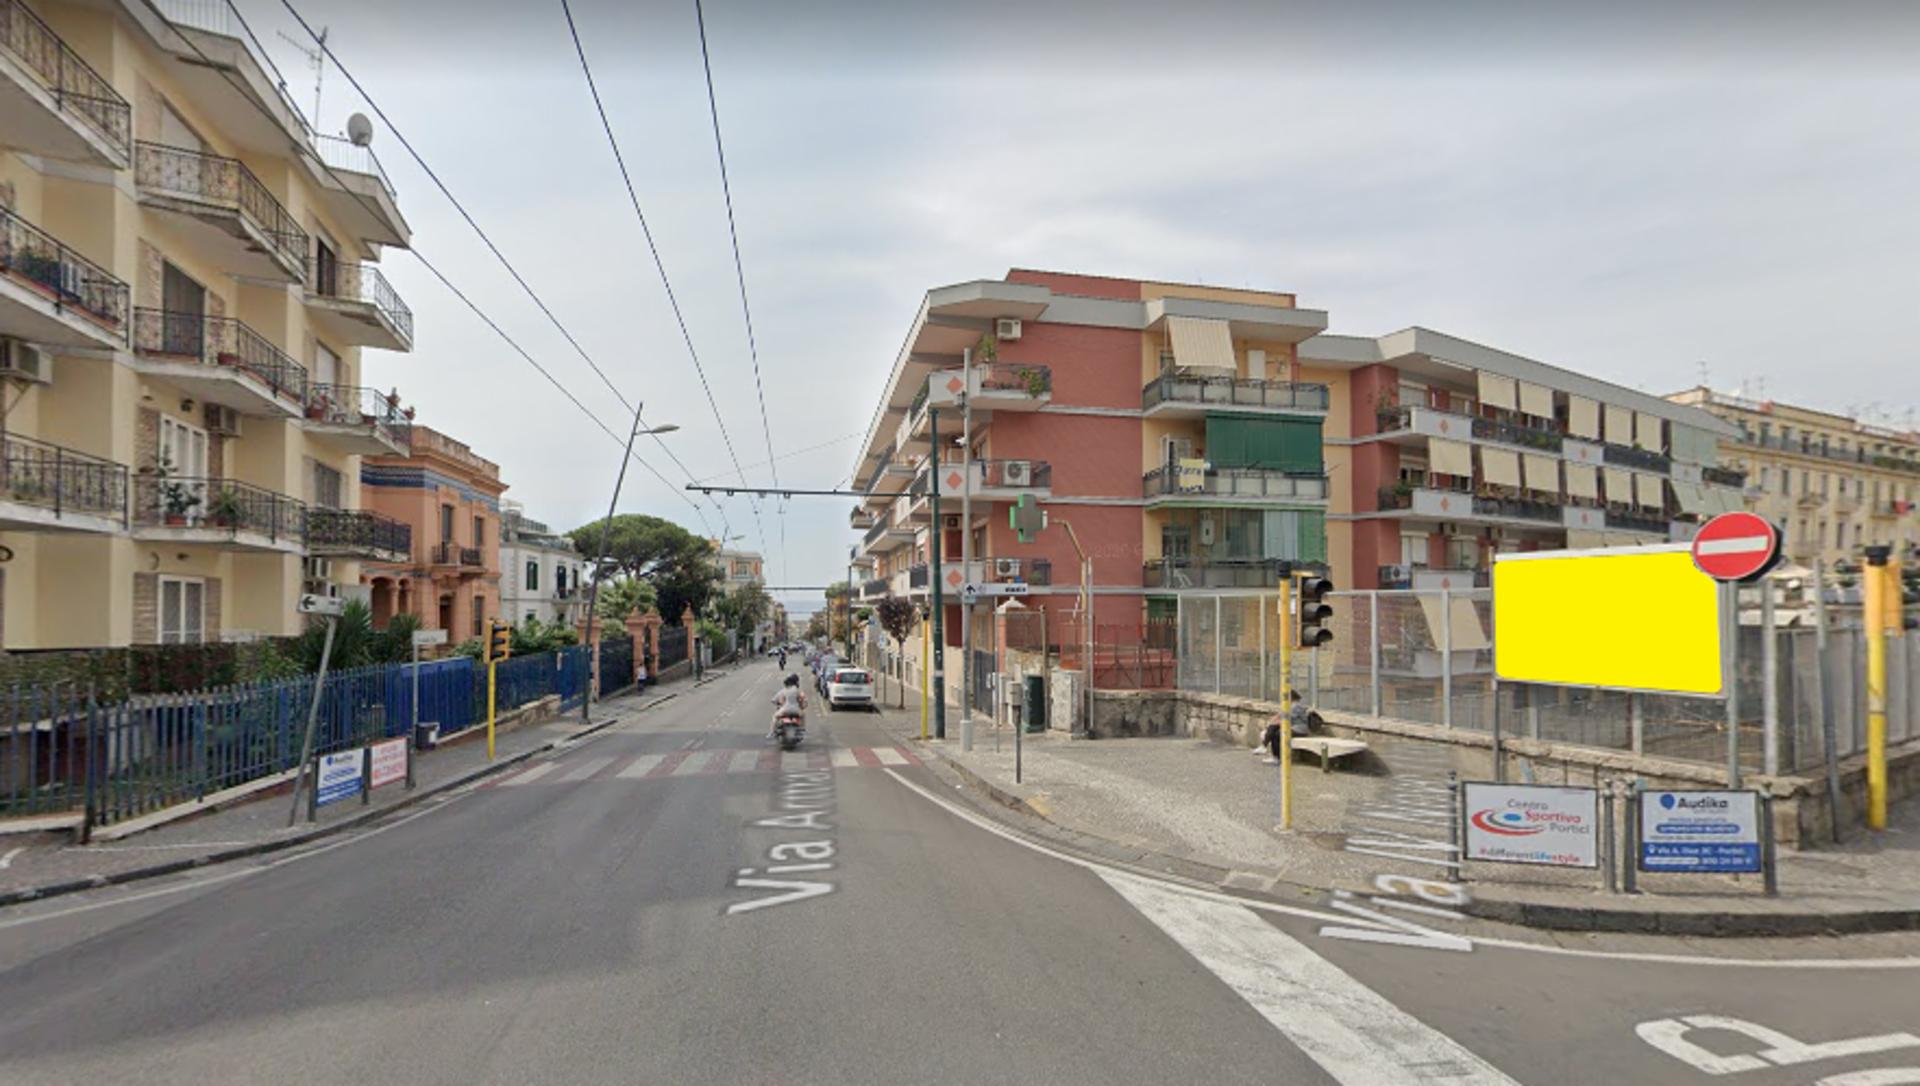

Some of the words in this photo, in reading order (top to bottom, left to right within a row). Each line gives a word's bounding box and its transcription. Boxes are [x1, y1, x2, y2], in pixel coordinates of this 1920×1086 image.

[1678, 796, 1729, 809] Audika
[1524, 809, 1582, 824] Sportivo
[1549, 822, 1590, 834] Portici
